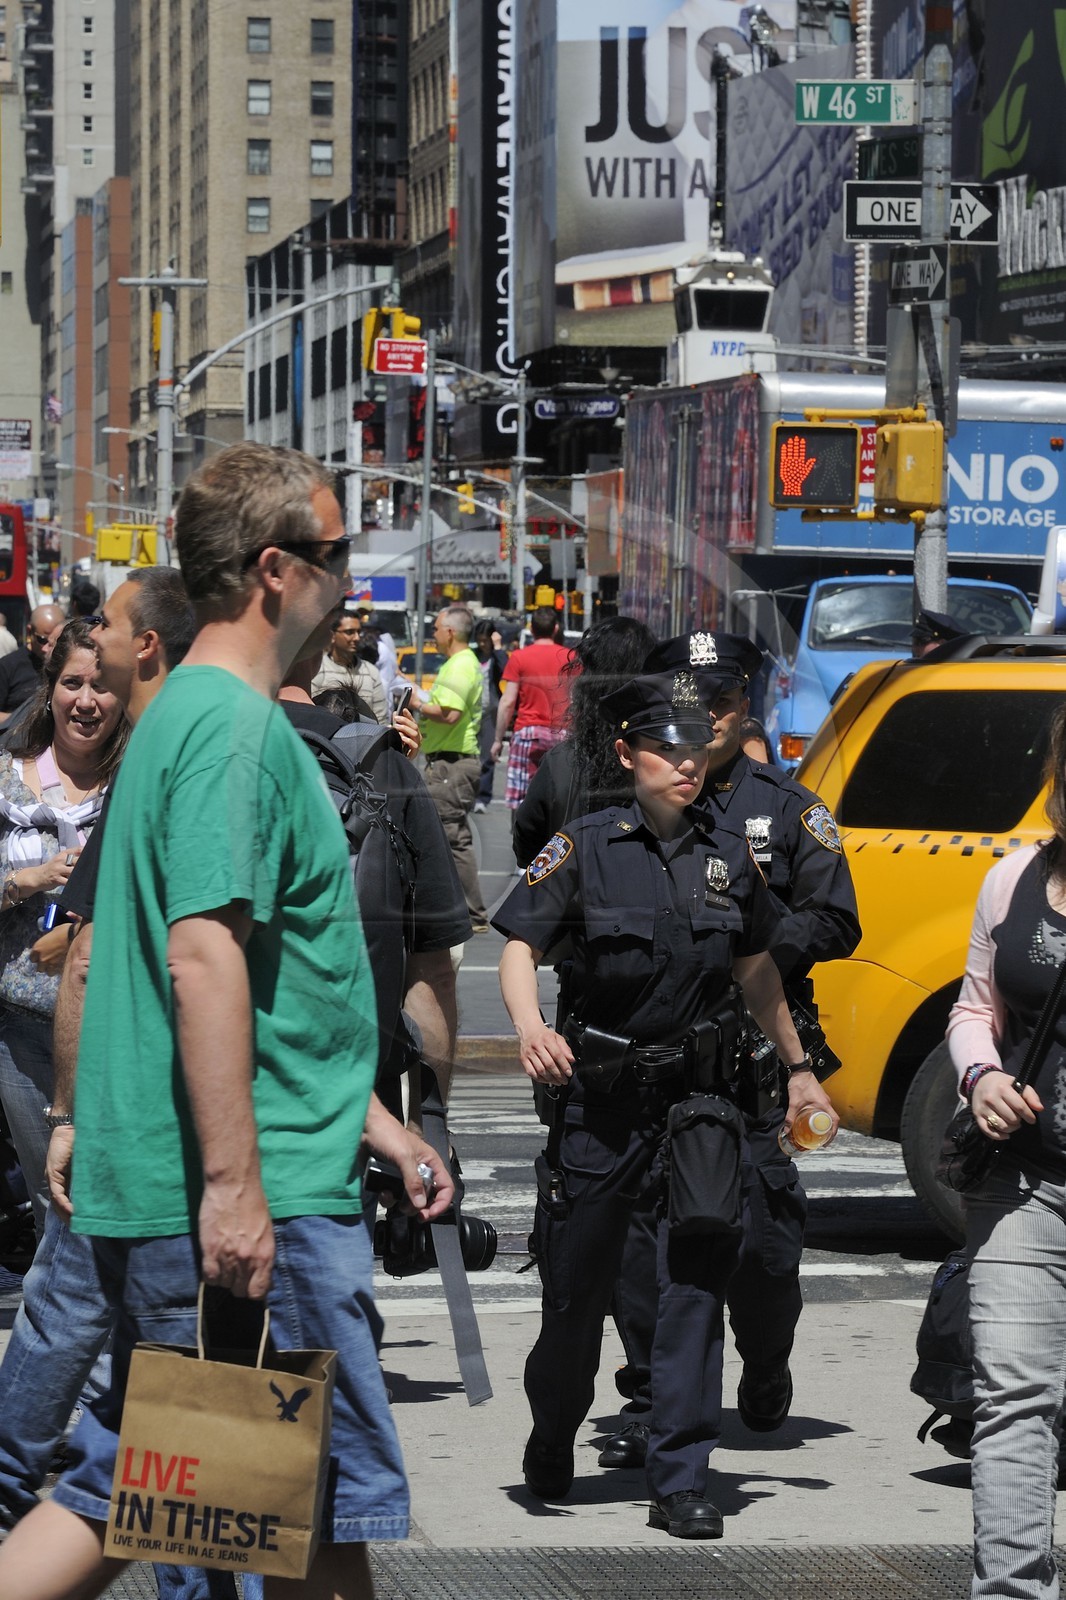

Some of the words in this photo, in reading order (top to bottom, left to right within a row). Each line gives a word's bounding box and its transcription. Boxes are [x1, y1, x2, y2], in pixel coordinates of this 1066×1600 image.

[802, 86, 820, 119] W
[828, 87, 857, 120] 46
[865, 86, 885, 104] ST
[585, 157, 676, 198] WITH
[688, 158, 710, 198] A
[870, 201, 917, 222] ONE
[950, 202, 978, 225] AY
[895, 264, 911, 286] ONE
[918, 262, 938, 285] WAY
[380, 343, 390, 351] NO
[949, 506, 1056, 527] STORAGE
[121, 1446, 200, 1497] LIVE
[115, 1491, 154, 1534] IN
[162, 1499, 281, 1552] THESE
[113, 1534, 133, 1547] LIVE
[136, 1538, 161, 1551] YOUR
[165, 1541, 184, 1554] LIFE
[187, 1544, 198, 1556] IN
[201, 1546, 214, 1558] AE
[217, 1549, 249, 1563] JEANS
